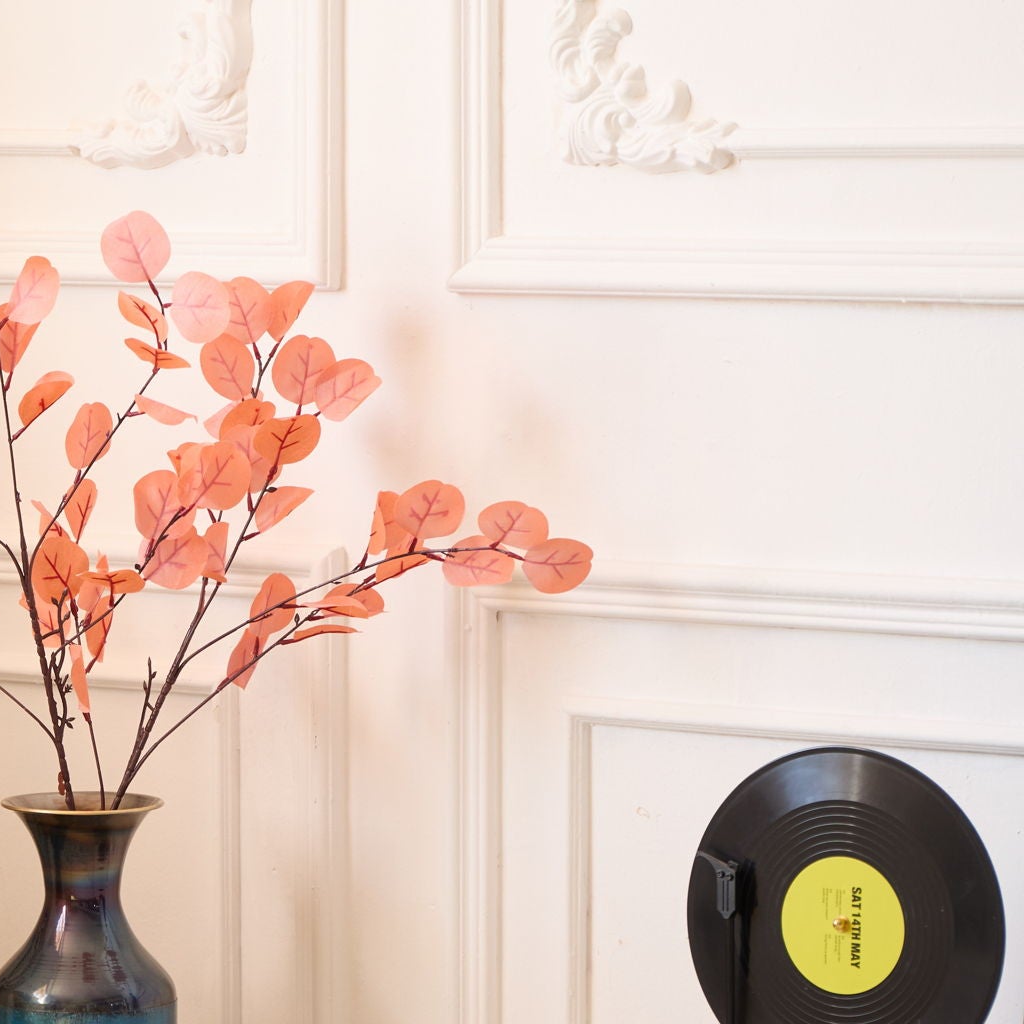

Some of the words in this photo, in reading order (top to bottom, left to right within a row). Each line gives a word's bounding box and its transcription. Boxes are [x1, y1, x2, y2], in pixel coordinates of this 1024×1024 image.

[851, 887, 862, 910] SAT
[851, 912, 861, 941] 14TH
[850, 942, 861, 969] MAY
